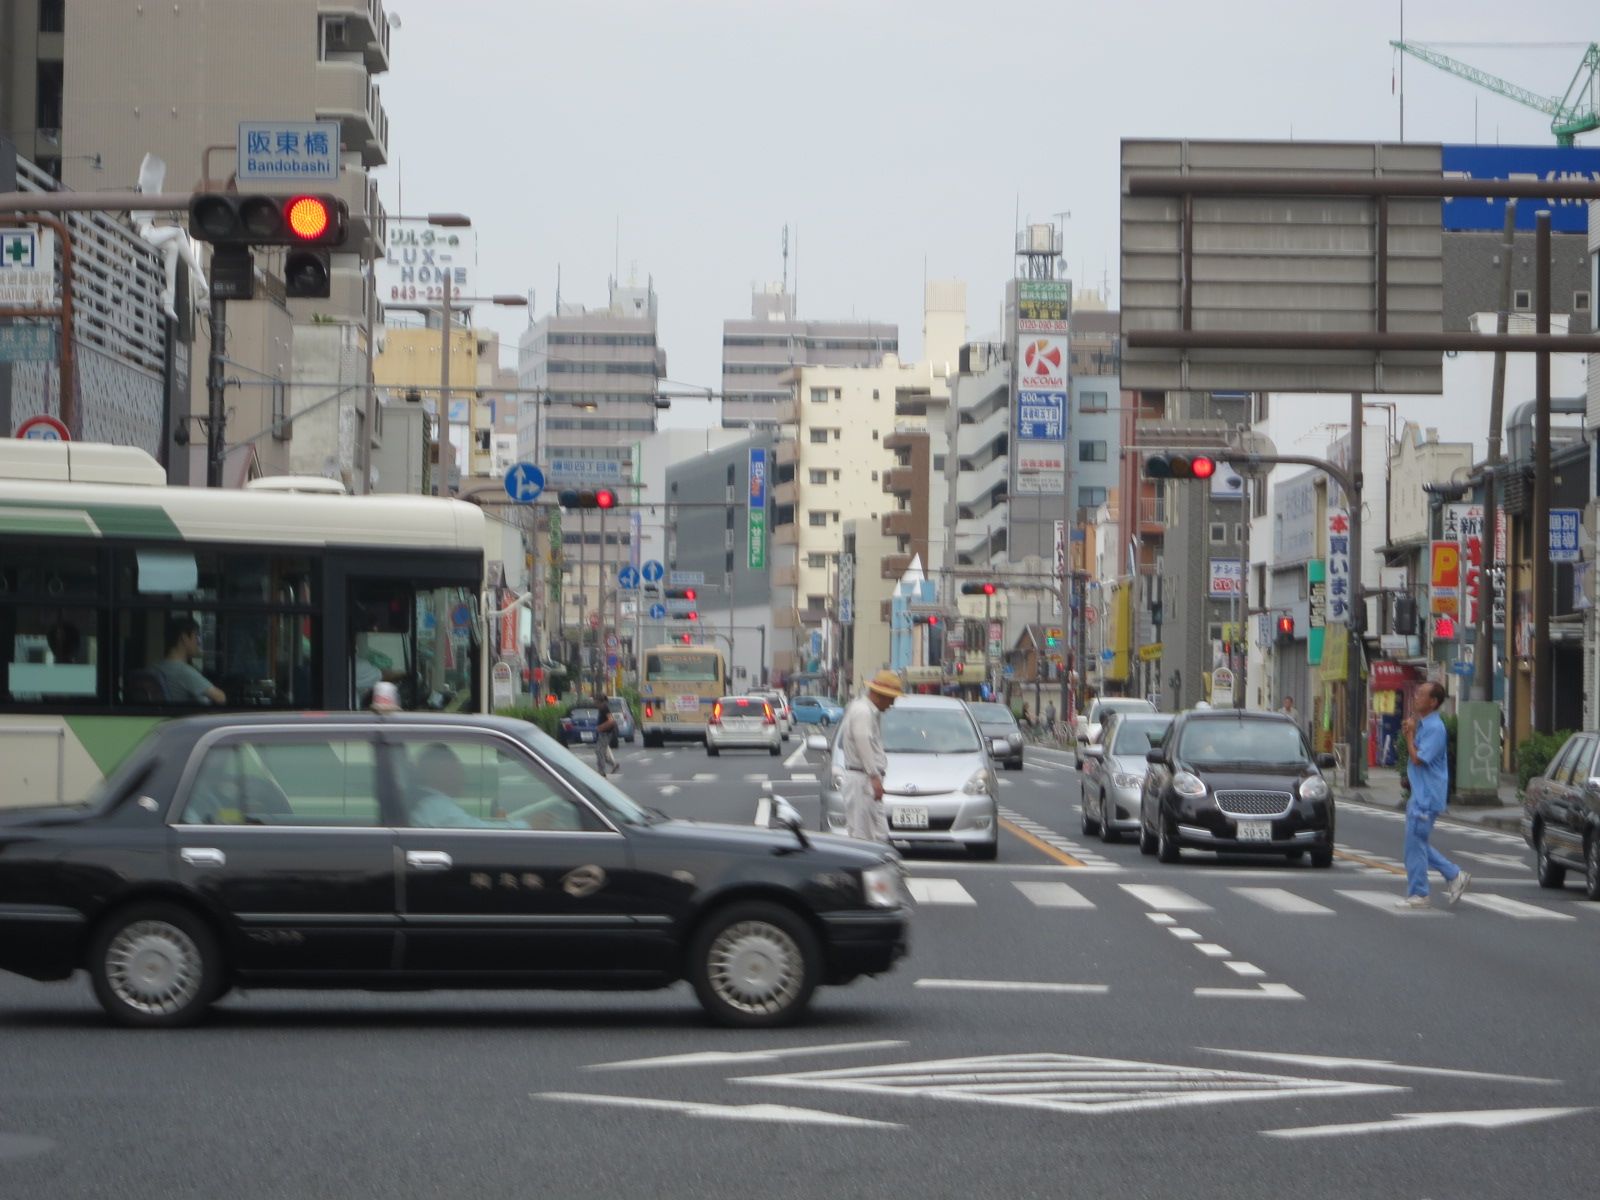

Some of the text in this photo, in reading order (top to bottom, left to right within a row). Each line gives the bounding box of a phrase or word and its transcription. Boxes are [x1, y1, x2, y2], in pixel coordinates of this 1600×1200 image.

[247, 129, 329, 155] 阪東橋
[247, 158, 330, 173] Bandobashi
[386, 247, 452, 266] LUX-
[1329, 514, 1349, 617] 本買います
